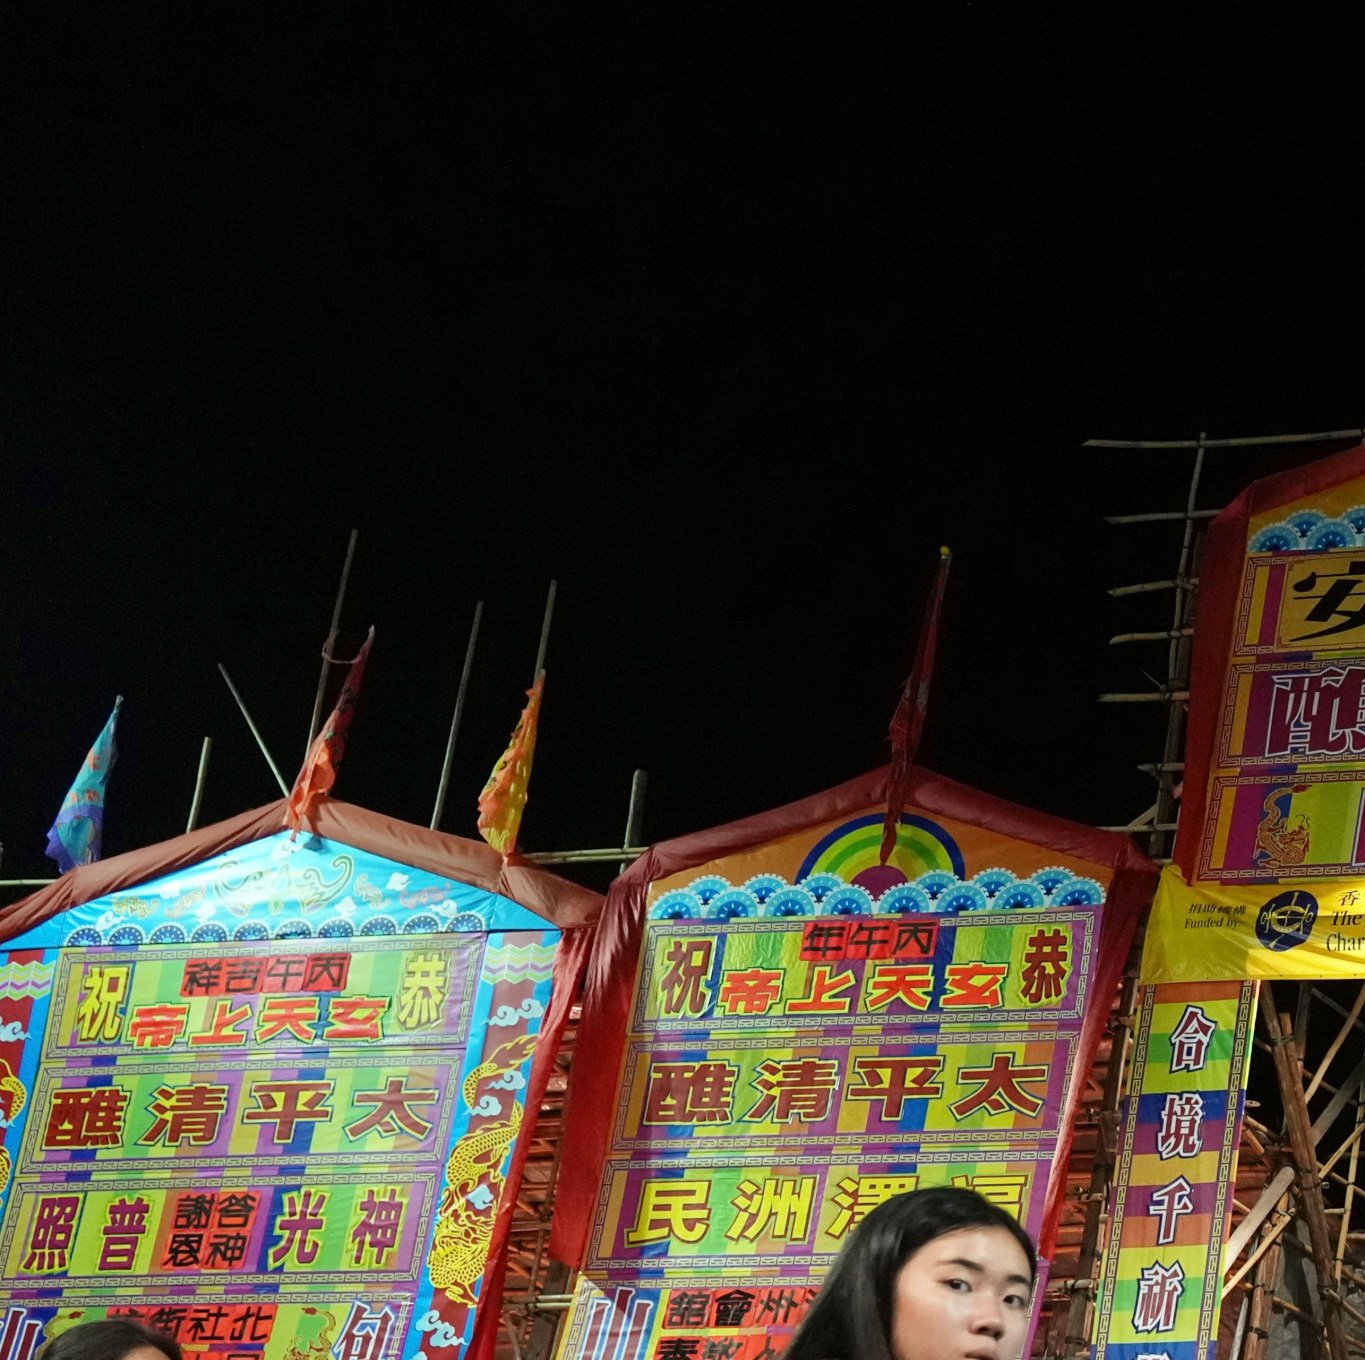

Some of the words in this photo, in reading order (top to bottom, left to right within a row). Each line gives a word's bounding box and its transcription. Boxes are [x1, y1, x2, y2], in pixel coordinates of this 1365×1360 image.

[803, 921, 938, 959] 丙午年
[1184, 918, 1224, 930] Funded
[1331, 911, 1362, 926] The
[397, 953, 451, 1032] 恭
[660, 938, 714, 1016] 祝
[720, 963, 1008, 1016] 玄天上帝
[1020, 929, 1070, 1003] 恭
[75, 963, 133, 1042] 祝
[127, 993, 391, 1050] 玄天上帝
[43, 1079, 440, 1150] 太平清醮
[643, 1053, 1052, 1127] 太平清醮
[112, 1305, 273, 1342] 北社街
[667, 1288, 818, 1328] 州會館
